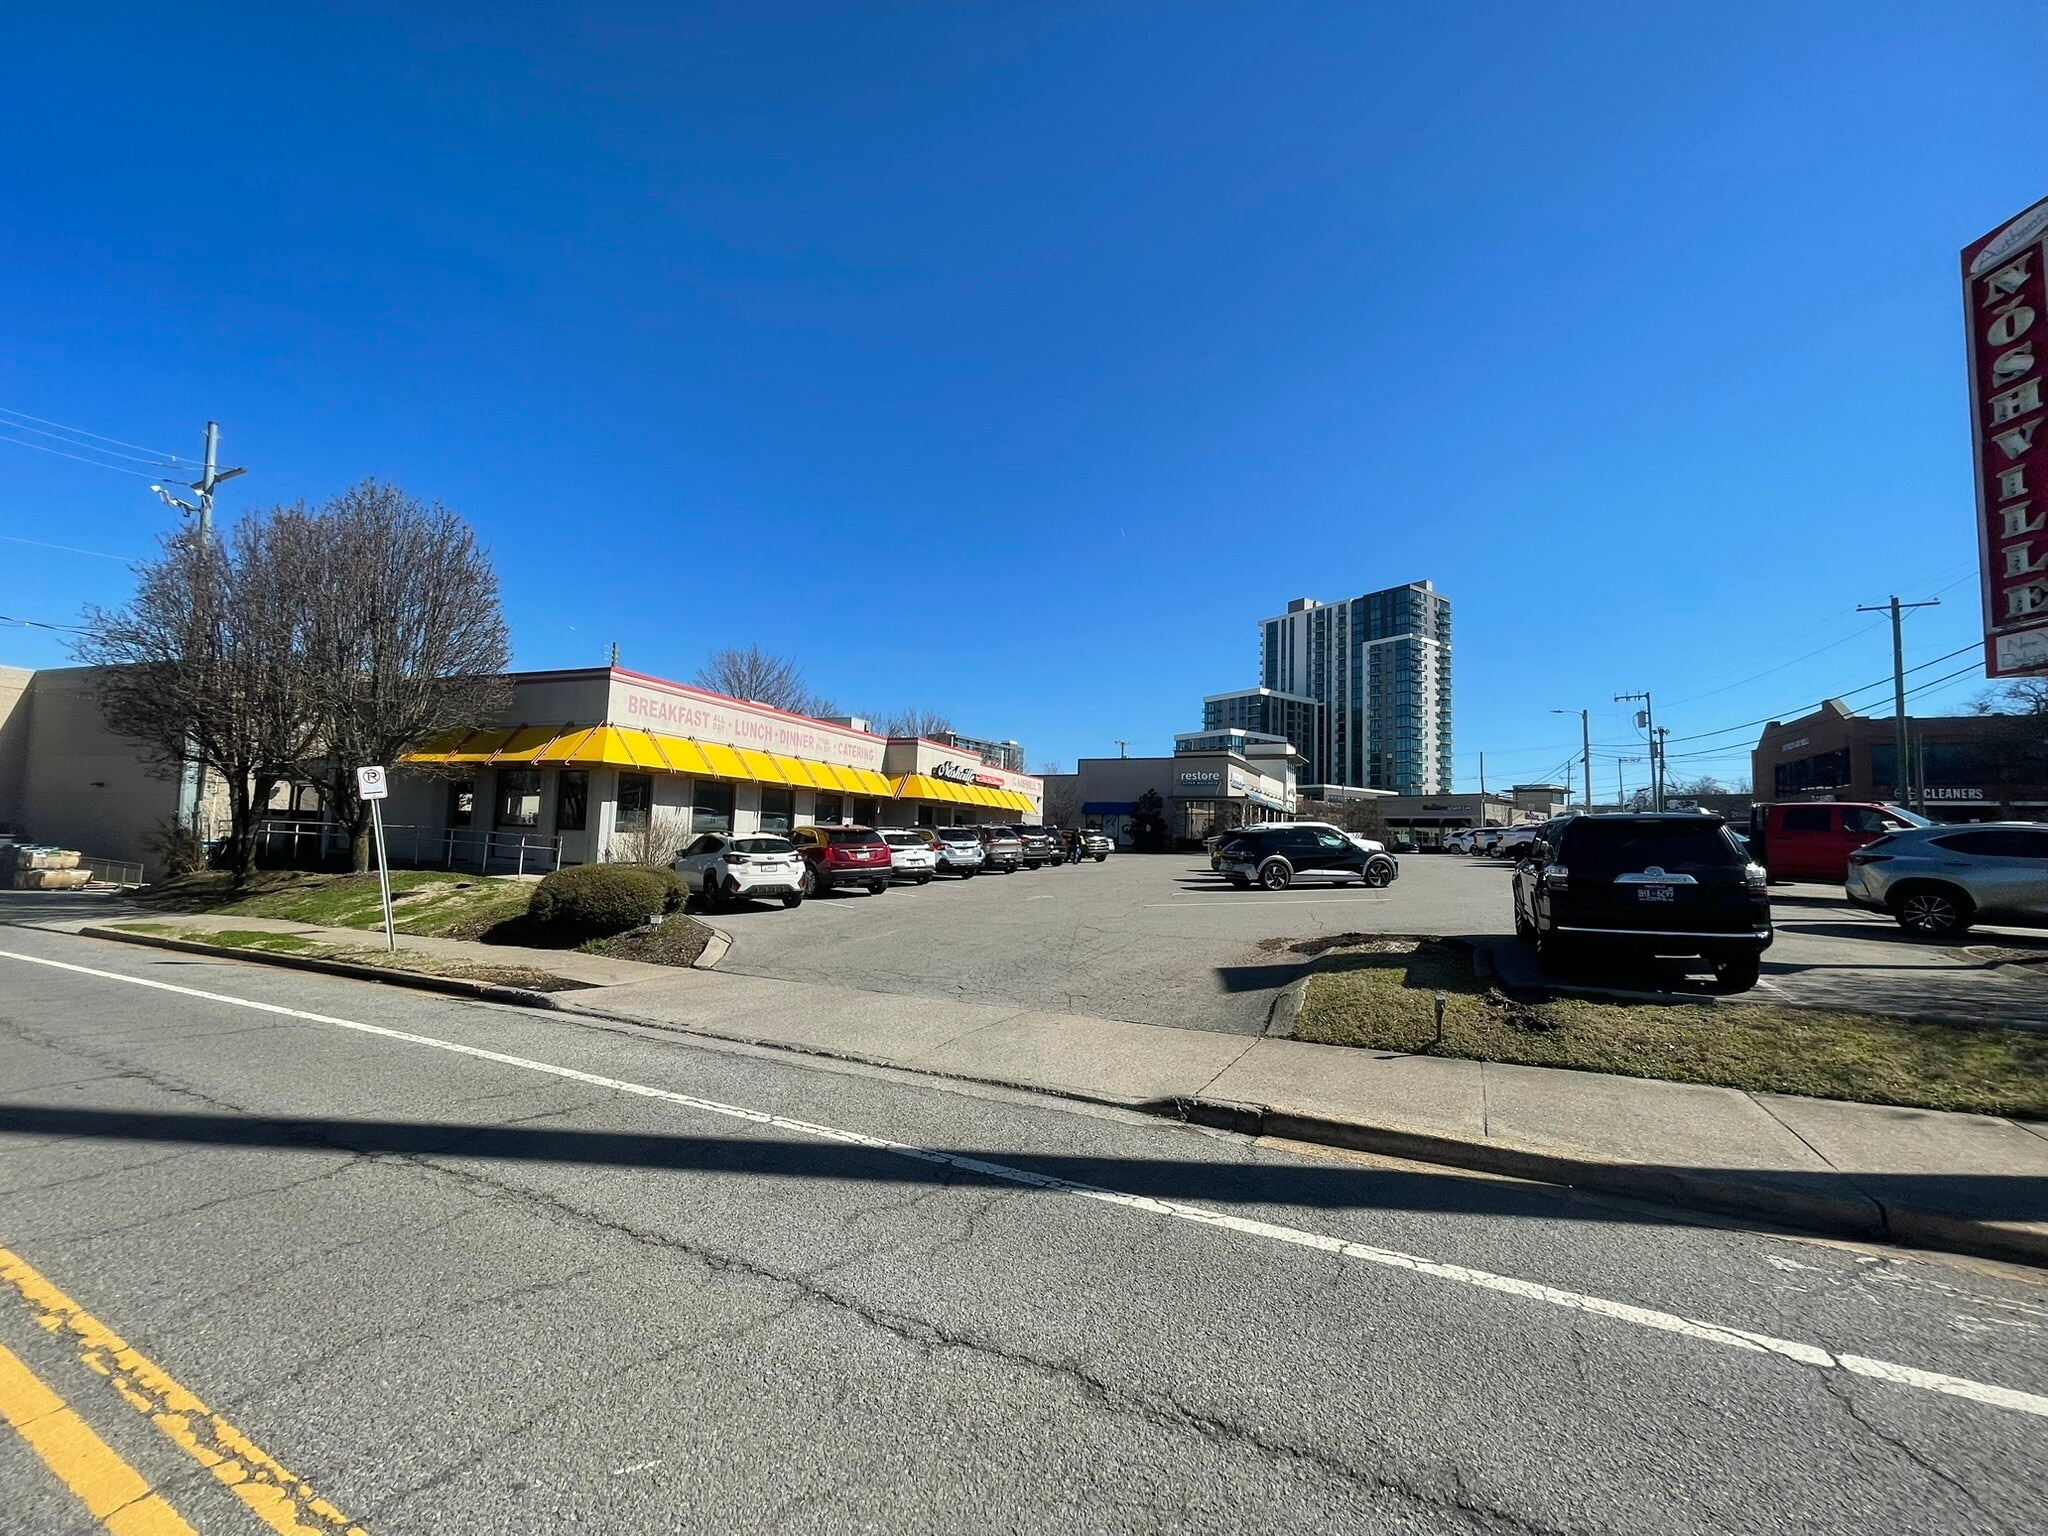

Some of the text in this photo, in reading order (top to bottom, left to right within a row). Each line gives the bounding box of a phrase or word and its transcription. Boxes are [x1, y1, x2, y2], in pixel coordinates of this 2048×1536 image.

[628, 694, 711, 728] BREAKFAST
[713, 713, 725, 724] ALL
[734, 719, 772, 742] LUNCH
[779, 729, 815, 750] DINNER
[838, 741, 875, 761] CATERING
[1181, 771, 1220, 780] restore
[1923, 788, 1984, 799] CLEANERS
